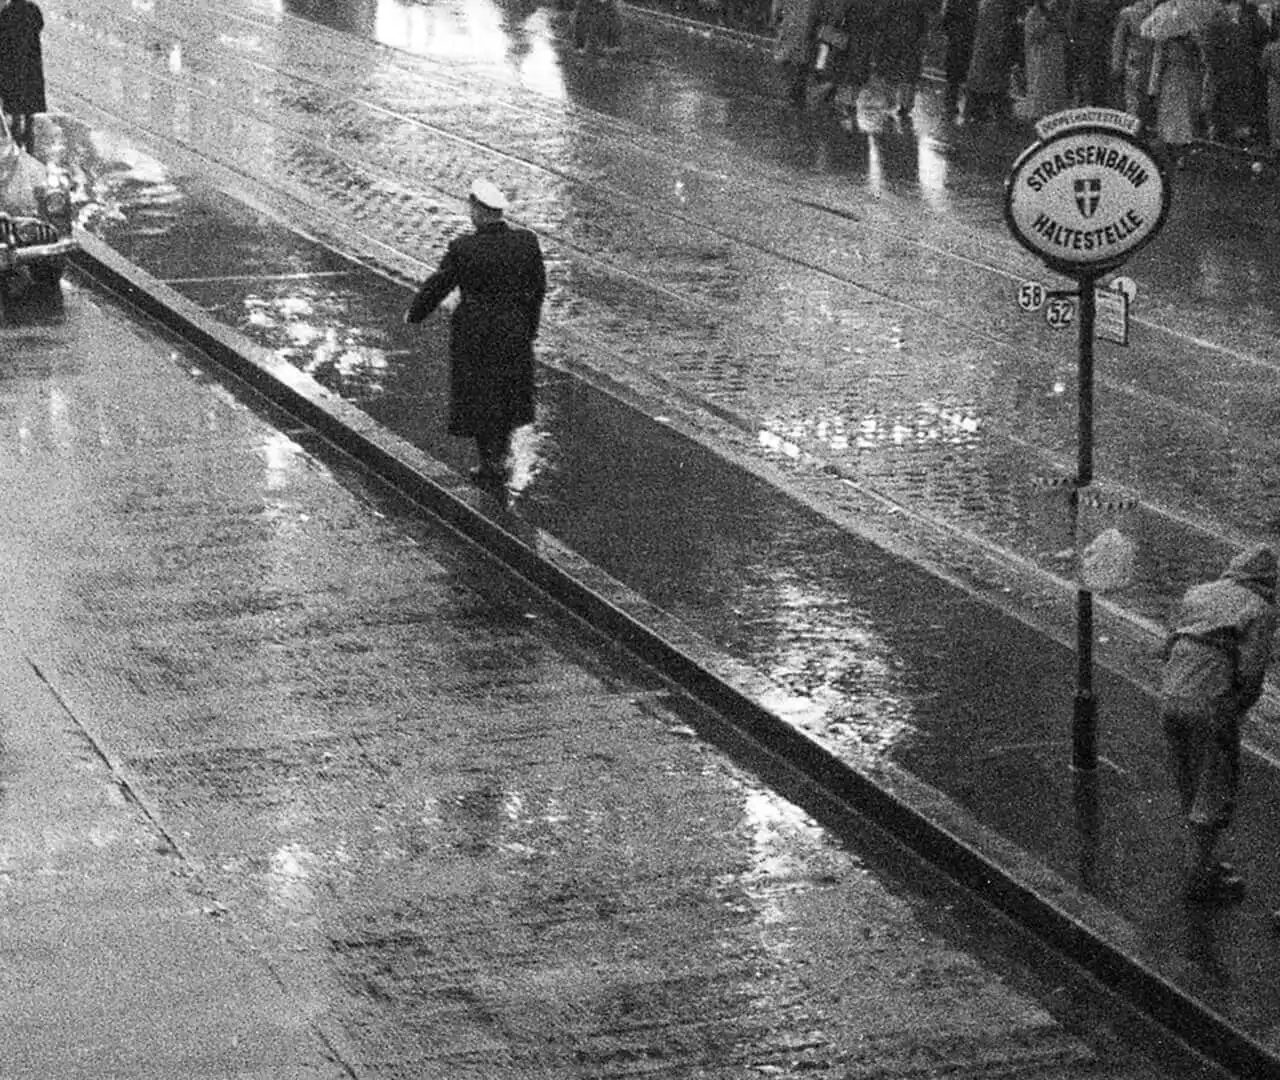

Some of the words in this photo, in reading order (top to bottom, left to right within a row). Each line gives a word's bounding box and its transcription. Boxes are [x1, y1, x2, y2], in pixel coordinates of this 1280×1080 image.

[1026, 145, 1149, 193] STRASSENBAHN
[1031, 209, 1144, 251] HALTESTELLE
[1022, 285, 1043, 308] 58
[1050, 302, 1071, 325] 52
